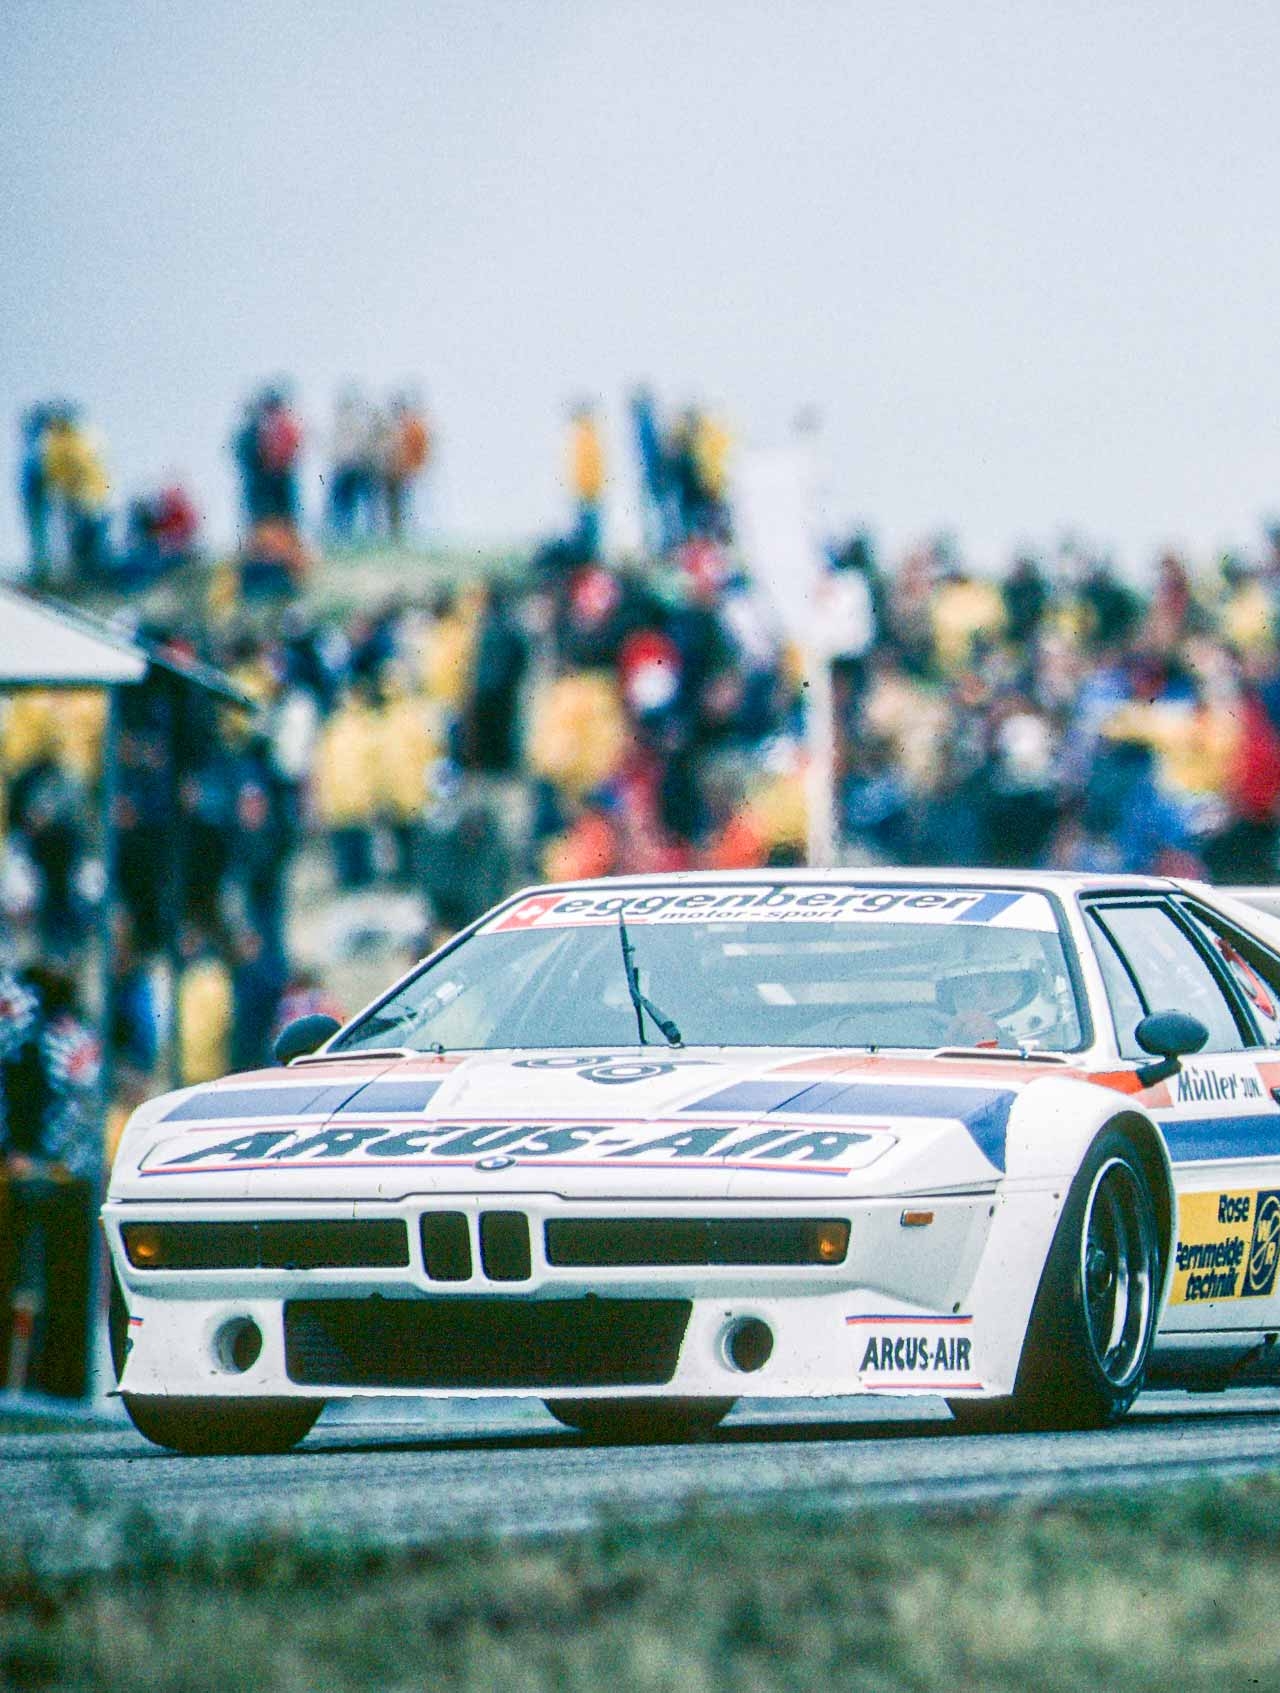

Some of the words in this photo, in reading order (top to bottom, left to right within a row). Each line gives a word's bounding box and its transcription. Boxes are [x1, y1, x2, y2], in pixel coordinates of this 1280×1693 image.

[551, 884, 979, 918] eggenberger
[1178, 1065, 1238, 1102] Müller
[160, 1124, 876, 1167] ARCUS-AIR
[1217, 1193, 1250, 1224] Rose
[1184, 1267, 1239, 1301] technik
